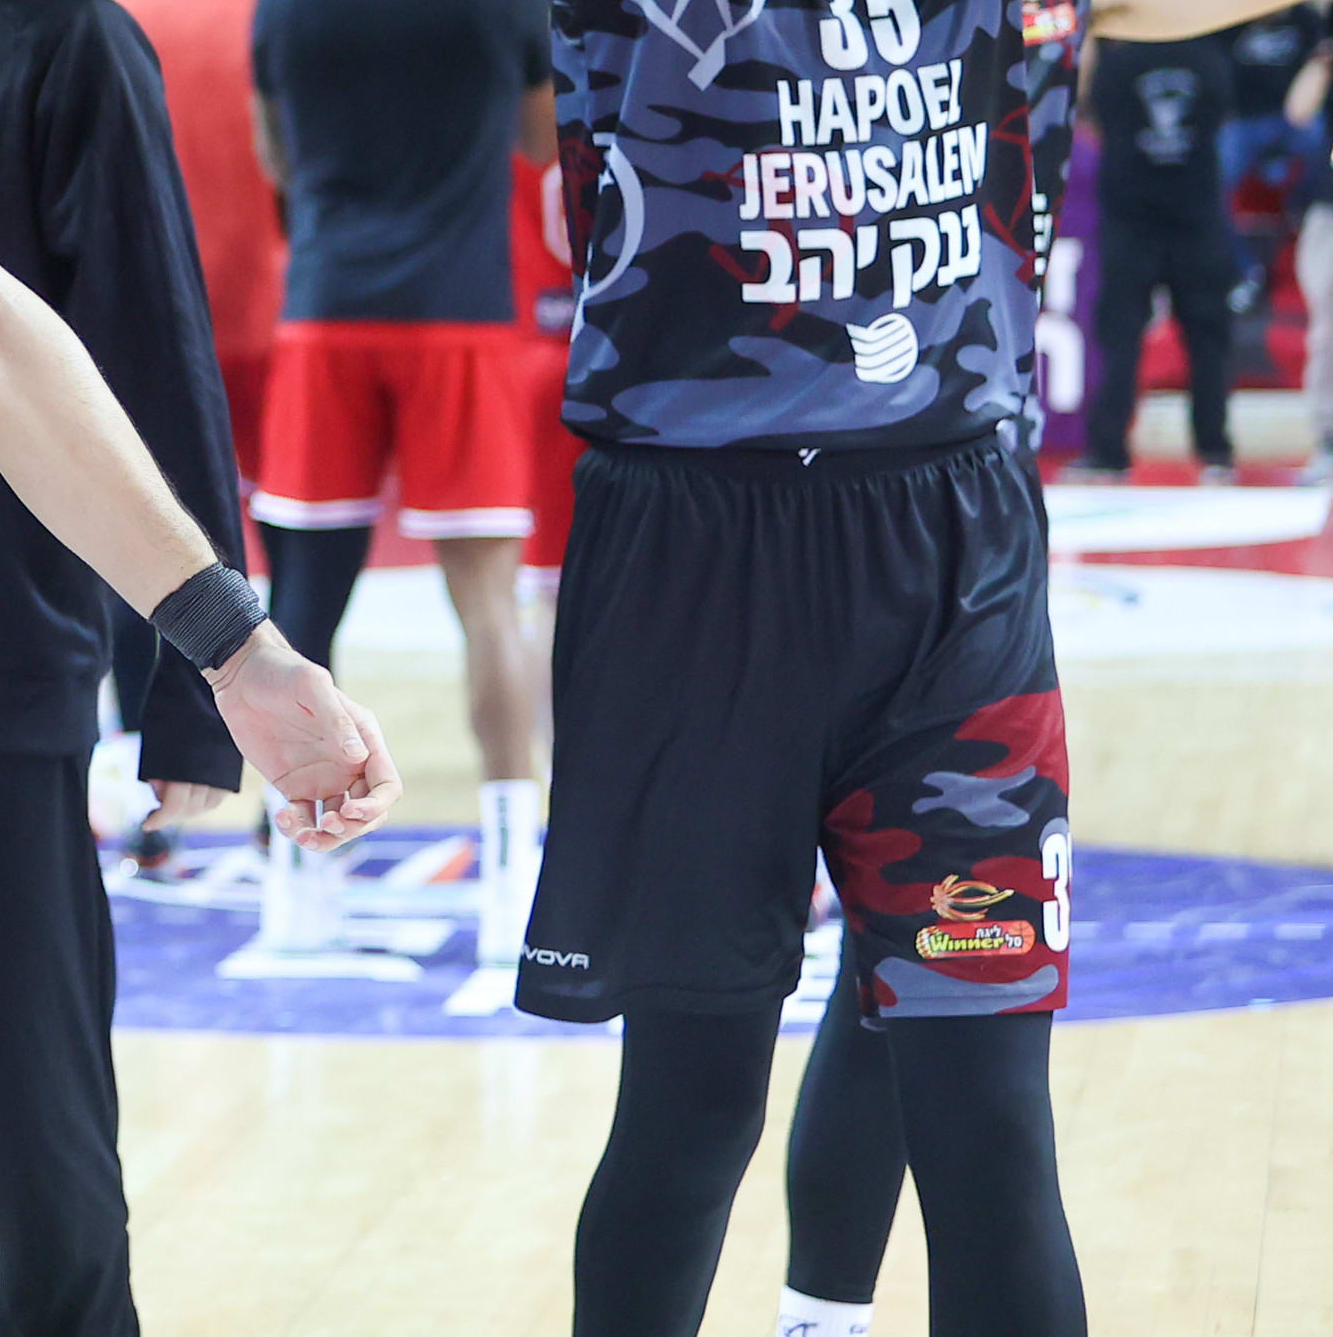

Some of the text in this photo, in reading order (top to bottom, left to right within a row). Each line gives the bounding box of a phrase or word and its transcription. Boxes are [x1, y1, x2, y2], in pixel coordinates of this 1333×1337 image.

[776, 58, 963, 147] HAPOEL
[739, 224, 879, 304] יהב
[1041, 832, 1072, 952] 3
[522, 942, 590, 970] VOVA
[929, 933, 1006, 953] Winner
